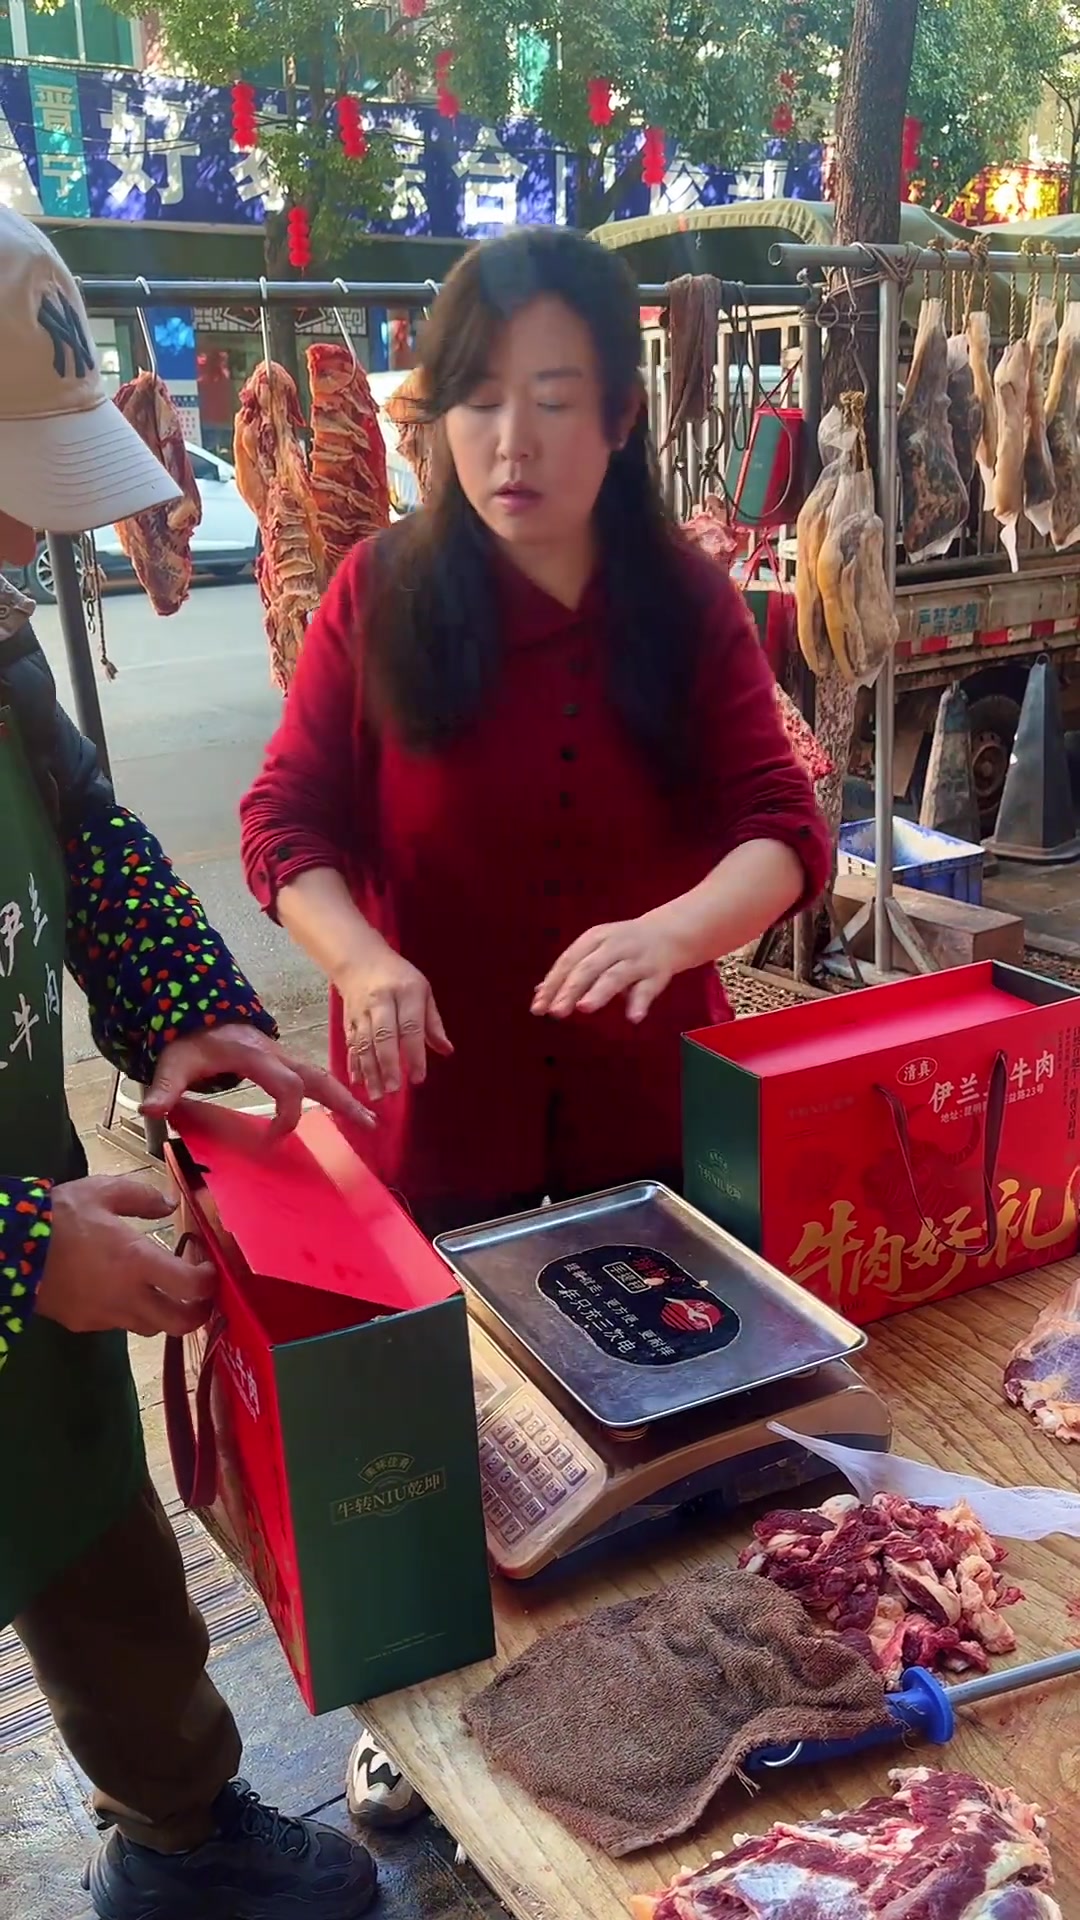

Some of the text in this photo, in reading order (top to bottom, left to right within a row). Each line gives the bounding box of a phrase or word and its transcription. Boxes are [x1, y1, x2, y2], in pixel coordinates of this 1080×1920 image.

[37, 288, 95, 378] NY
[903, 1060, 931, 1082] 清真
[928, 1050, 1055, 1114] 伊兰牛肉
[787, 1164, 1080, 1302] 牛肉好礼
[556, 1280, 638, 1354] 一年只充三次电
[496, 1425, 532, 1464] 4 5 6
[515, 1406, 551, 1446] 7 8 9
[486, 1457, 498, 1470] 2
[500, 1471, 512, 1483] 3
[337, 1473, 441, 1518] 牛转NIU乾坤
